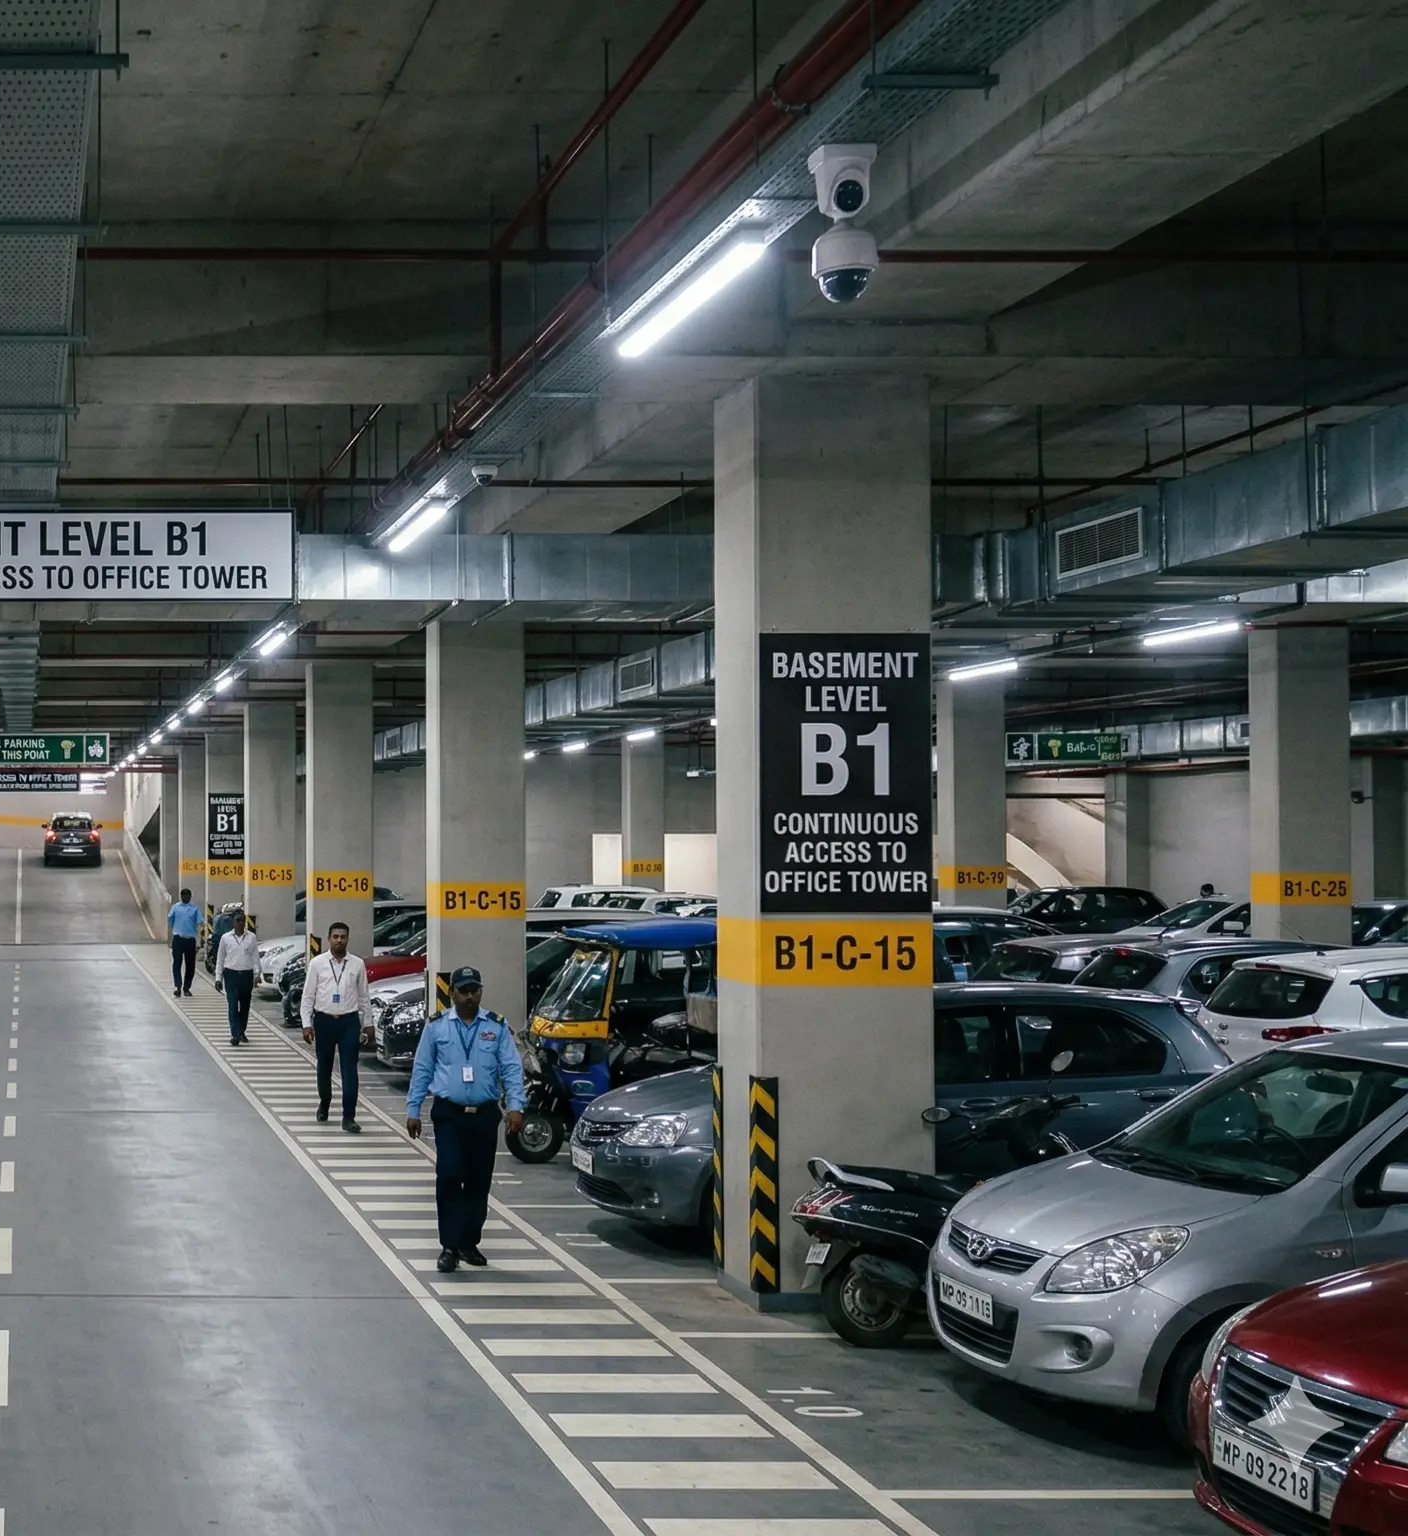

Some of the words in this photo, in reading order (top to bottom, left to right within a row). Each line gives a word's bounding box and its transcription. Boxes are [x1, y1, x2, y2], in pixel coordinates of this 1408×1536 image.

[40, 521, 153, 556] LEVEL
[167, 521, 208, 556] B1
[44, 565, 74, 590] TO
[83, 565, 169, 590] OFFICE
[179, 565, 268, 589] TOWER
[772, 652, 918, 679] BASEMENT
[805, 686, 886, 712] LEVEL
[2, 750, 22, 760] THIS
[4, 739, 45, 749] PARKING
[801, 722, 889, 796] B1
[217, 814, 238, 832] B1
[774, 812, 918, 835] CONTINUOUS
[785, 841, 871, 864] ACCESS
[878, 842, 907, 864] TO
[252, 868, 292, 881] B1-C-15
[316, 878, 368, 892] B1-C-16
[765, 871, 841, 893] OFFICE
[848, 871, 927, 892] TOWER
[445, 891, 521, 910] B1-C-15
[1284, 881, 1346, 897] B1-C-25
[775, 935, 916, 971] B1-C-15
[1268, 1462, 1308, 1500] 2218
